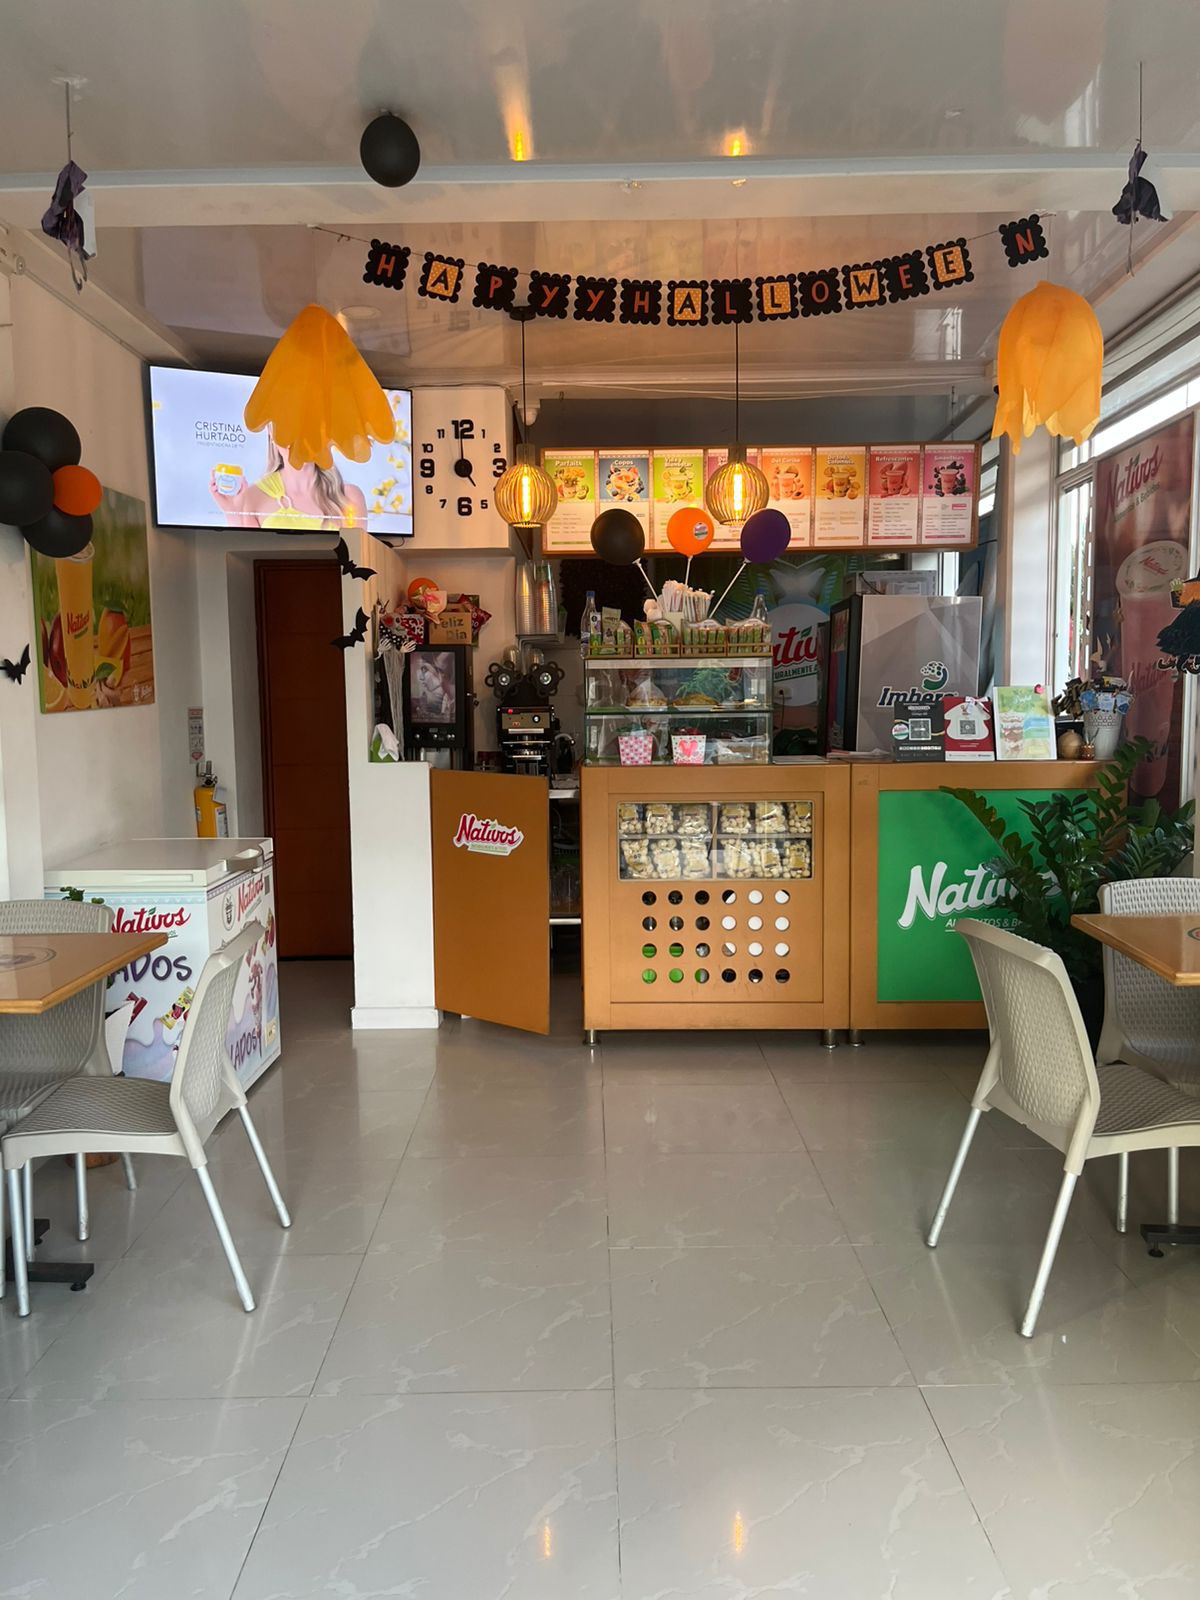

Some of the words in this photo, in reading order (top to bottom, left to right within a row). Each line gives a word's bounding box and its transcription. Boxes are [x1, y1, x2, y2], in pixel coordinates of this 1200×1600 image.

[195, 421, 243, 432] CRISTINA
[451, 419, 474, 439] 12
[195, 431, 246, 443] HURTADO
[437, 429, 445, 439] 11
[481, 429, 485, 438] 1
[422, 443, 433, 453] 10
[494, 443, 501, 453] 2
[493, 458, 507, 478] 3
[614, 459, 634, 467] Copos
[420, 459, 434, 478] 9
[1105, 445, 1164, 519] Nativos
[425, 485, 433, 494] 8
[439, 499, 446, 508] 7
[457, 497, 472, 516] 6
[480, 499, 488, 509] 5
[456, 814, 521, 845] Nativos
